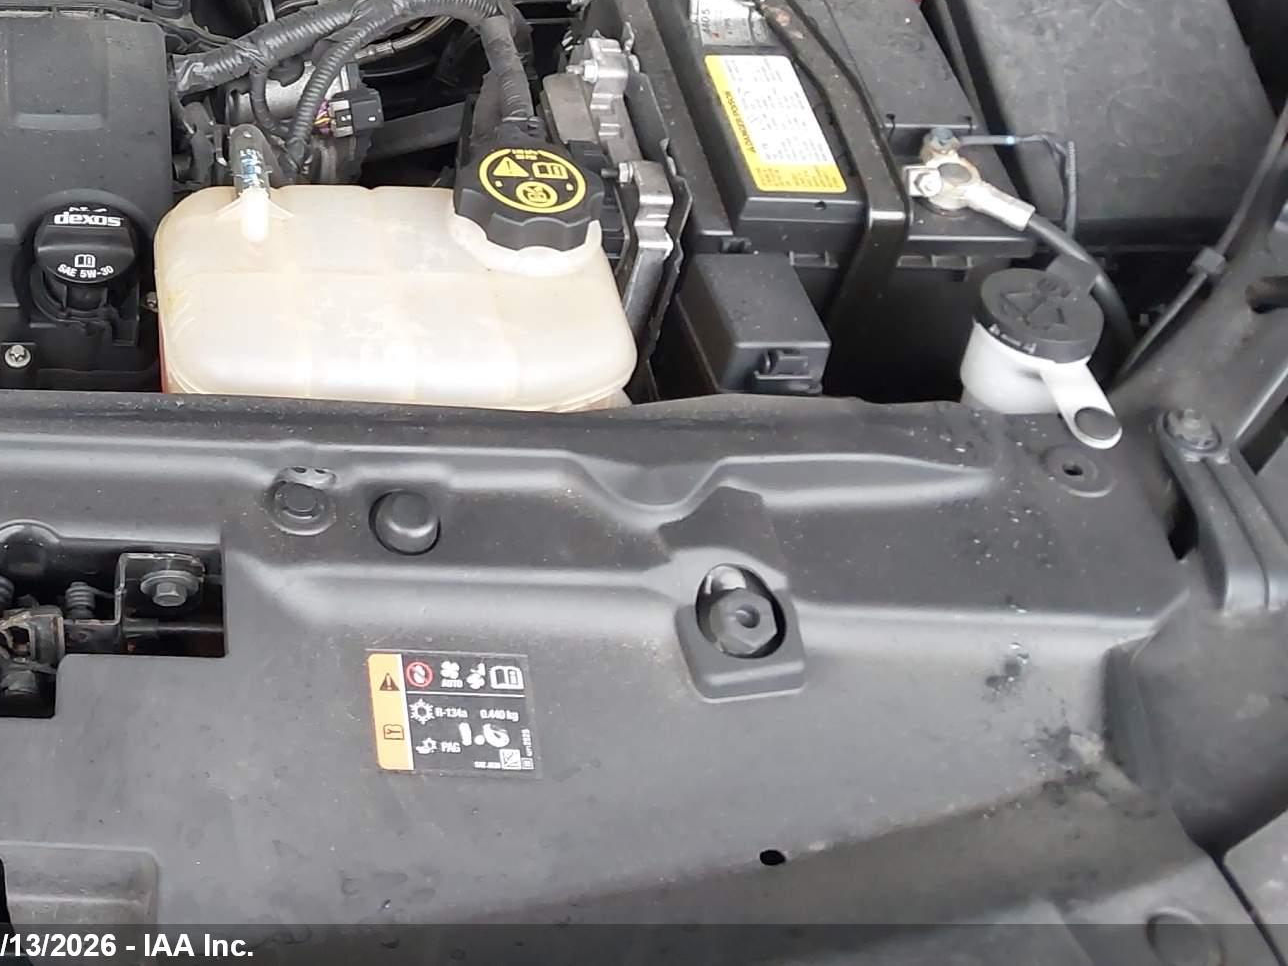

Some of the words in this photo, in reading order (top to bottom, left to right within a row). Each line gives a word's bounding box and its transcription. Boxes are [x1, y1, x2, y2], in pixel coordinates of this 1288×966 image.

[54, 211, 122, 227] dexos
[57, 263, 78, 278] SAE
[79, 265, 114, 279] 5W-30
[440, 741, 462, 754] PAG
